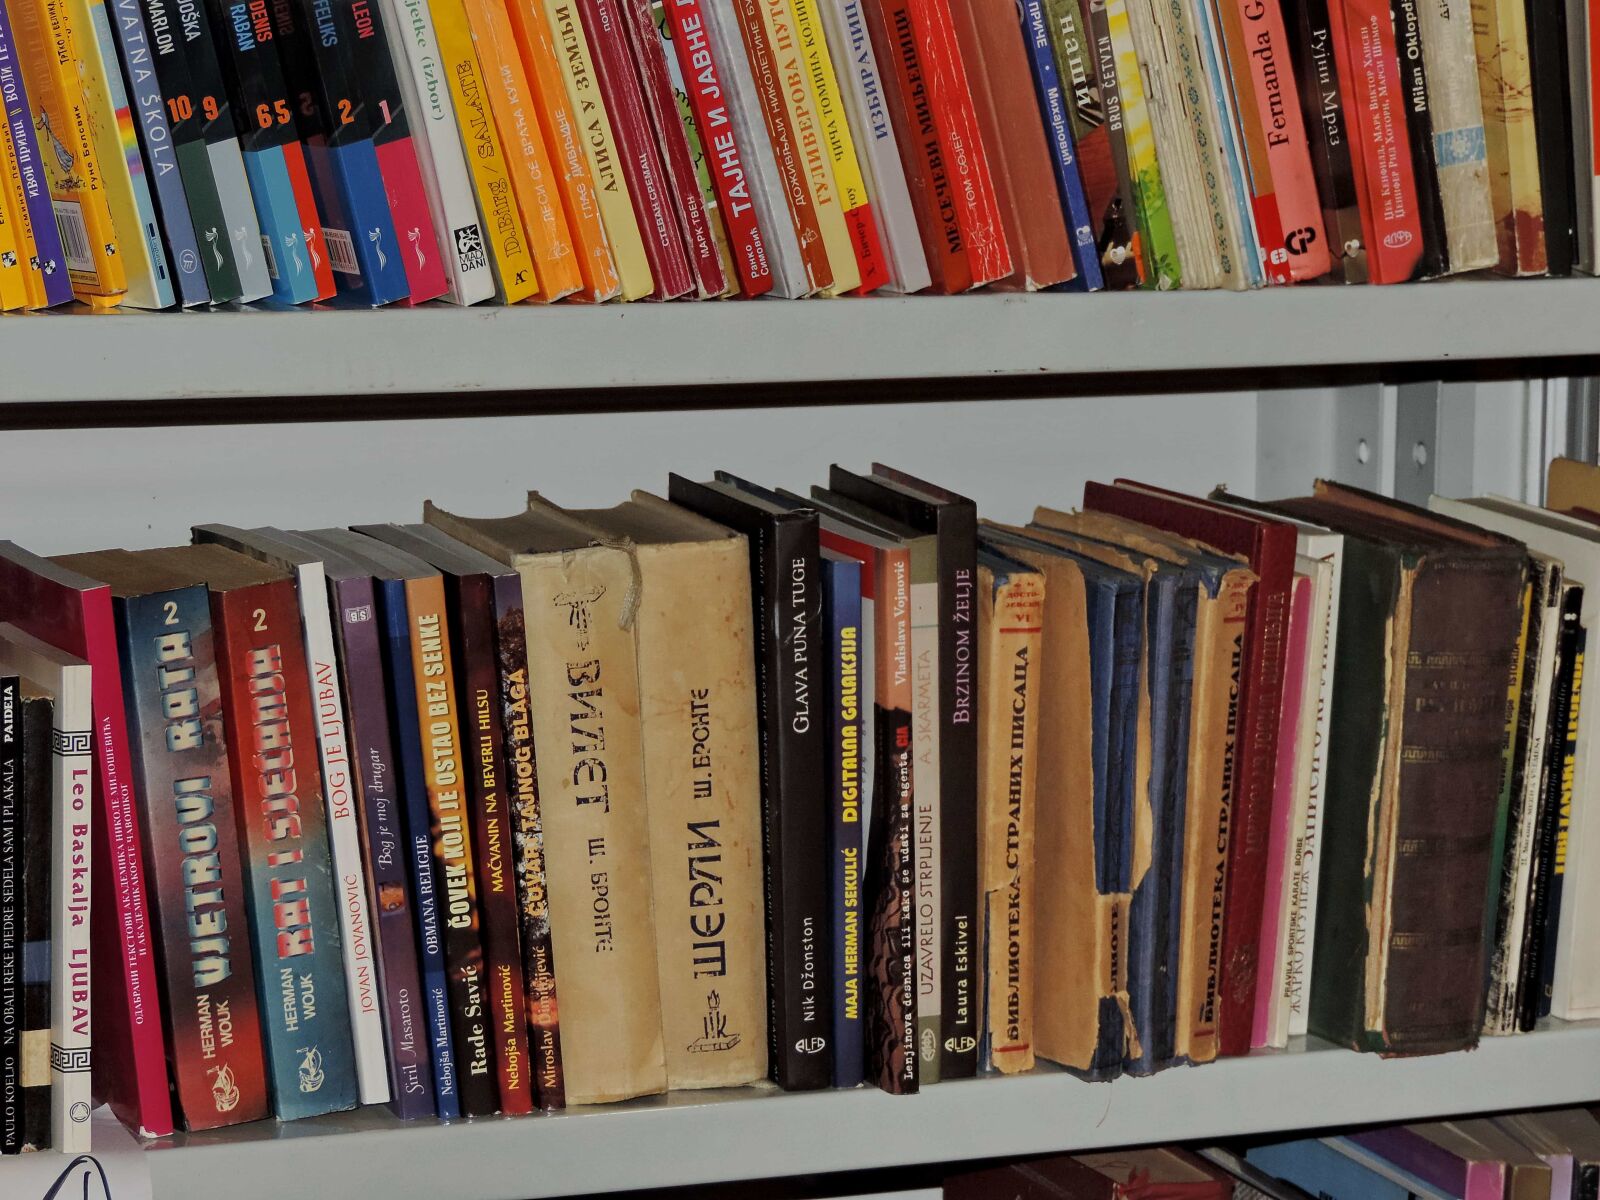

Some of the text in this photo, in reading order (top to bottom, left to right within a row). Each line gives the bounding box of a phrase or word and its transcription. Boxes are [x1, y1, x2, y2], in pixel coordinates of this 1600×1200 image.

[147, 0, 175, 55] MARLON
[229, 3, 256, 52] RABAN
[249, 0, 273, 43] DENIS
[313, 0, 338, 48] FELIKS
[351, 0, 375, 39] LEON
[681, 13, 720, 99] ЈАВНЕ
[73, 105, 91, 157] Белсвик
[142, 94, 175, 177] ŠKOLA
[167, 95, 193, 123] 10
[202, 95, 219, 120] 9
[256, 104, 272, 128] 6
[273, 99, 292, 125] 5
[337, 99, 355, 125] 2
[378, 100, 392, 125] 1
[421, 55, 446, 121] (izbor)
[455, 60, 496, 159] SALATE
[555, 5, 619, 194] АЛИСА У ЗЕМЉИ
[708, 106, 728, 127] И
[750, 20, 807, 206] ДОЖИВЉАЈИ НИКОЛЕТИНЕ
[784, 58, 832, 206] ГУЛИВЕРОВА
[809, 51, 844, 162] ЧИЧА ТОМИНА
[894, 9, 963, 254] МЕСЕЧЕВИ МИЉЕНИЦИ
[1029, 2, 1072, 166] ПРИЧЕ Михајловић
[1099, 37, 1122, 131] BRUS ČETVIN
[1253, 30, 1290, 149] Fernanda
[1311, 29, 1340, 146] Рујни Мраз
[1413, 67, 1427, 112] Milan
[527, 160, 542, 181] СЕ
[638, 153, 670, 248] СТЕВАН СРЕМАЦ
[714, 132, 752, 218] ТАЈНЕ
[951, 131, 977, 209] ТОМ СОЈЕР
[460, 258, 487, 273] DANI
[686, 195, 710, 258] МАРК ТВЕН
[745, 244, 760, 279] Ранко
[750, 226, 770, 276] Симовић
[163, 601, 179, 626] 2
[252, 608, 268, 632] 2
[792, 556, 810, 734] GLAVA PUNA TUGE
[893, 560, 907, 687] Vladislava Vojnović
[952, 568, 975, 725] BRZINOM ŽELJE
[314, 661, 350, 821] BOG JE LJUBAV
[418, 612, 472, 929] ČOVEK KOJI JE OSTAO BEZ SENKE
[477, 689, 504, 892] MAČVANIN NA BEVERLI HILSU
[508, 668, 543, 832] TAJNOG BLAGA
[121, 783, 135, 842] ЧАВОШКОГ
[153, 631, 233, 988] VJETROVI RATA
[247, 643, 315, 960] RAT SJEĆANJA
[369, 747, 396, 870] Bog je moj drugar
[840, 626, 858, 1020] MAJA HERMAN SEKULIĆ DIGITALNA GALAKSIJA
[918, 649, 934, 996] SKARMETA UZAVRELO STRPLJENJE
[1006, 645, 1029, 1041] БИБЛИОТЕКА СТРАНИХ ПИСАЦА
[3, 685, 16, 1146] PAULO KOELJO NA OBALI REKE PJEDRE SEDELA SAM PLAKALA PAIDEIA
[68, 769, 89, 1036] Leo Baskalja LJUBAV
[102, 716, 144, 1025] ОДАБРАНИ ТЕКСТОВИ АКАДЕМИКА НИКОЛЕ МИЛОШЕВИЋА
[415, 834, 439, 955] OBMANA RELIGIJE
[687, 819, 726, 979] ШЕРЛИ
[899, 751, 915, 1080] Lenjinova desnica ili kako se udati za agenta
[1205, 741, 1234, 1024] БИБЛИОТЕКА СТРАНИХ
[1283, 836, 1304, 998] PRAVILA SPORTSKE KARATE BORBE
[300, 972, 317, 1021] WOUK
[344, 873, 377, 1014] JOVAN JOVANOVIĆ
[801, 916, 815, 1022] Nik Džonston
[954, 915, 968, 1024] Laura Eskivel
[196, 993, 216, 1059] HERMAN
[216, 1000, 234, 1048] WOUK
[280, 967, 299, 1032] HERMAN
[399, 988, 425, 1096] Siril Masaroto
[436, 988, 454, 1096] Nebojša Martinović
[461, 966, 488, 1076] Rade Savić
[498, 965, 521, 1091] Nebojša Martinović
[540, 1030, 557, 1089] Miroslav
